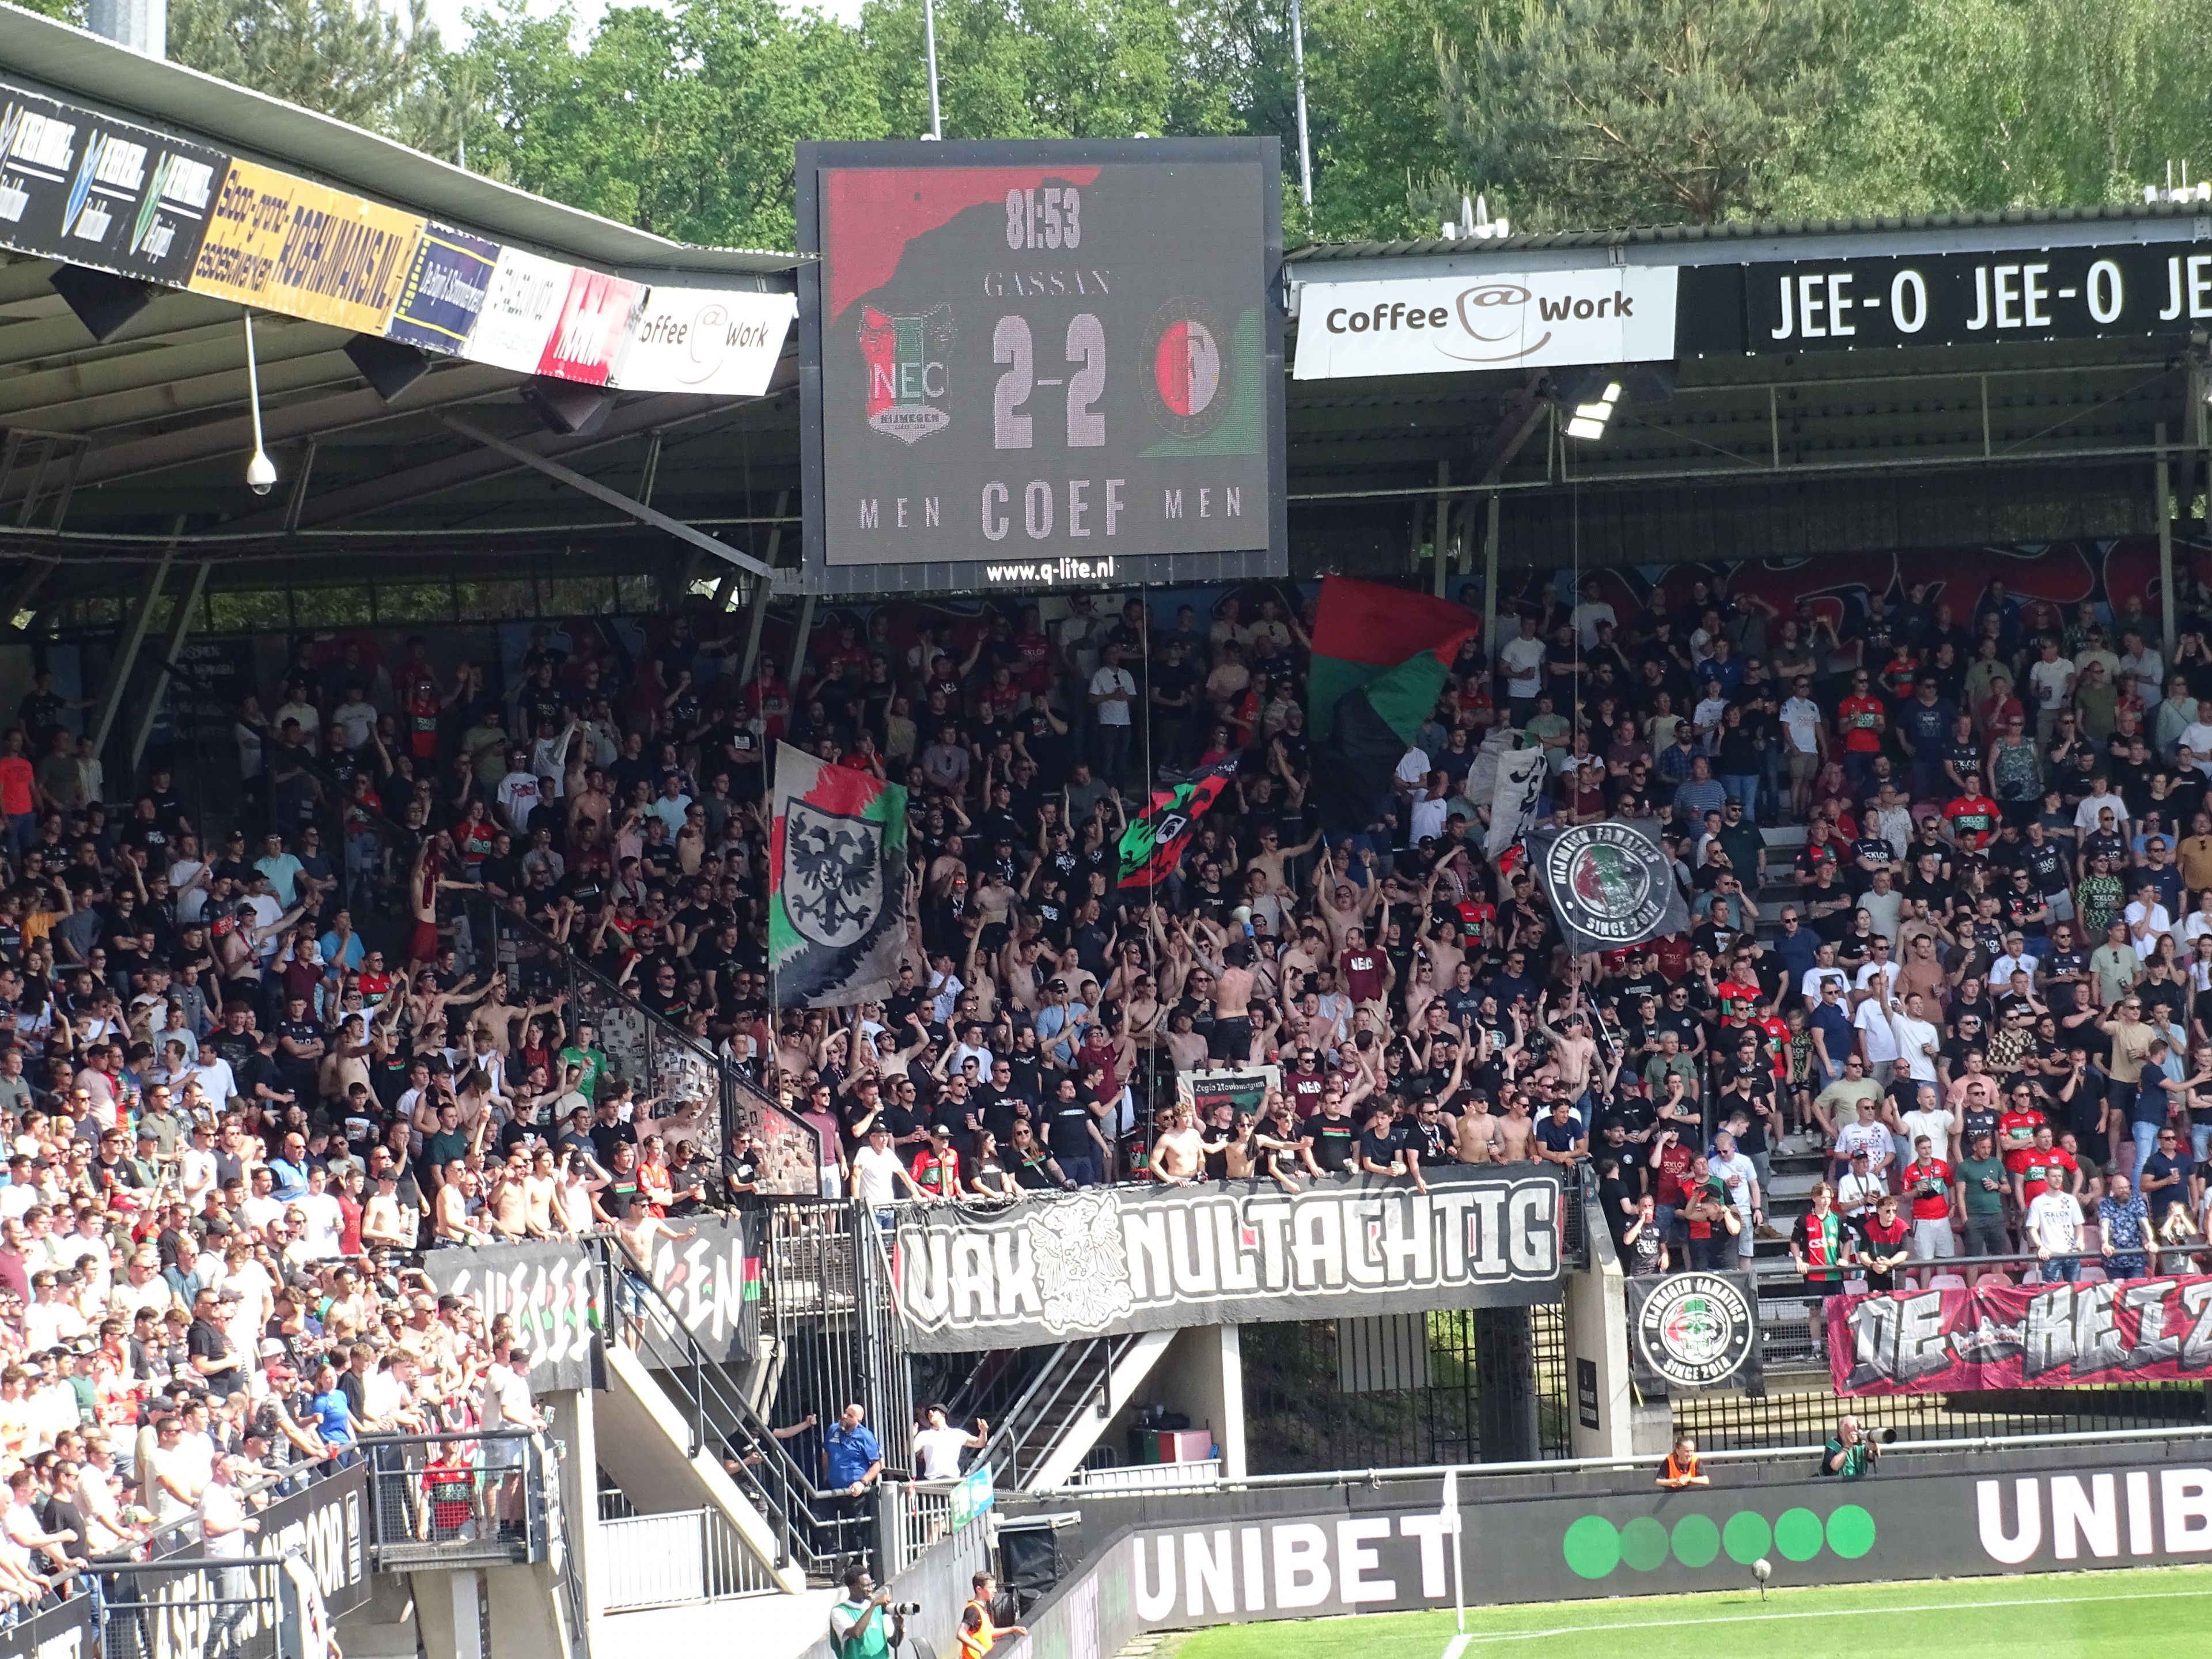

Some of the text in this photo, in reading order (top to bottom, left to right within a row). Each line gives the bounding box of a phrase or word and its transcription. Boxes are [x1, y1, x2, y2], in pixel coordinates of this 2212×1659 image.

[1006, 187, 1080, 249] 81:53
[984, 270, 1112, 296] GASSAN
[1966, 260, 2123, 330] JEE-O
[1326, 302, 1448, 334] Coffee
[1539, 290, 1634, 321] Work
[1771, 270, 1927, 339] JEE-O
[726, 321, 768, 347] Work
[874, 361, 945, 397] NEC
[859, 497, 940, 529] MEN
[982, 479, 1125, 540] COEF
[1164, 487, 1241, 519] MEN
[987, 557, 1114, 585] www.q-lite.nl
[1586, 917, 1627, 936] SINCE
[1122, 1187, 1556, 1299] NULTACHTIG
[1645, 1278, 1746, 1328] NIJMEGEN FANATICS
[1663, 1355, 1732, 1380] SINCE 2014
[1132, 1513, 1455, 1623] UNIBET
